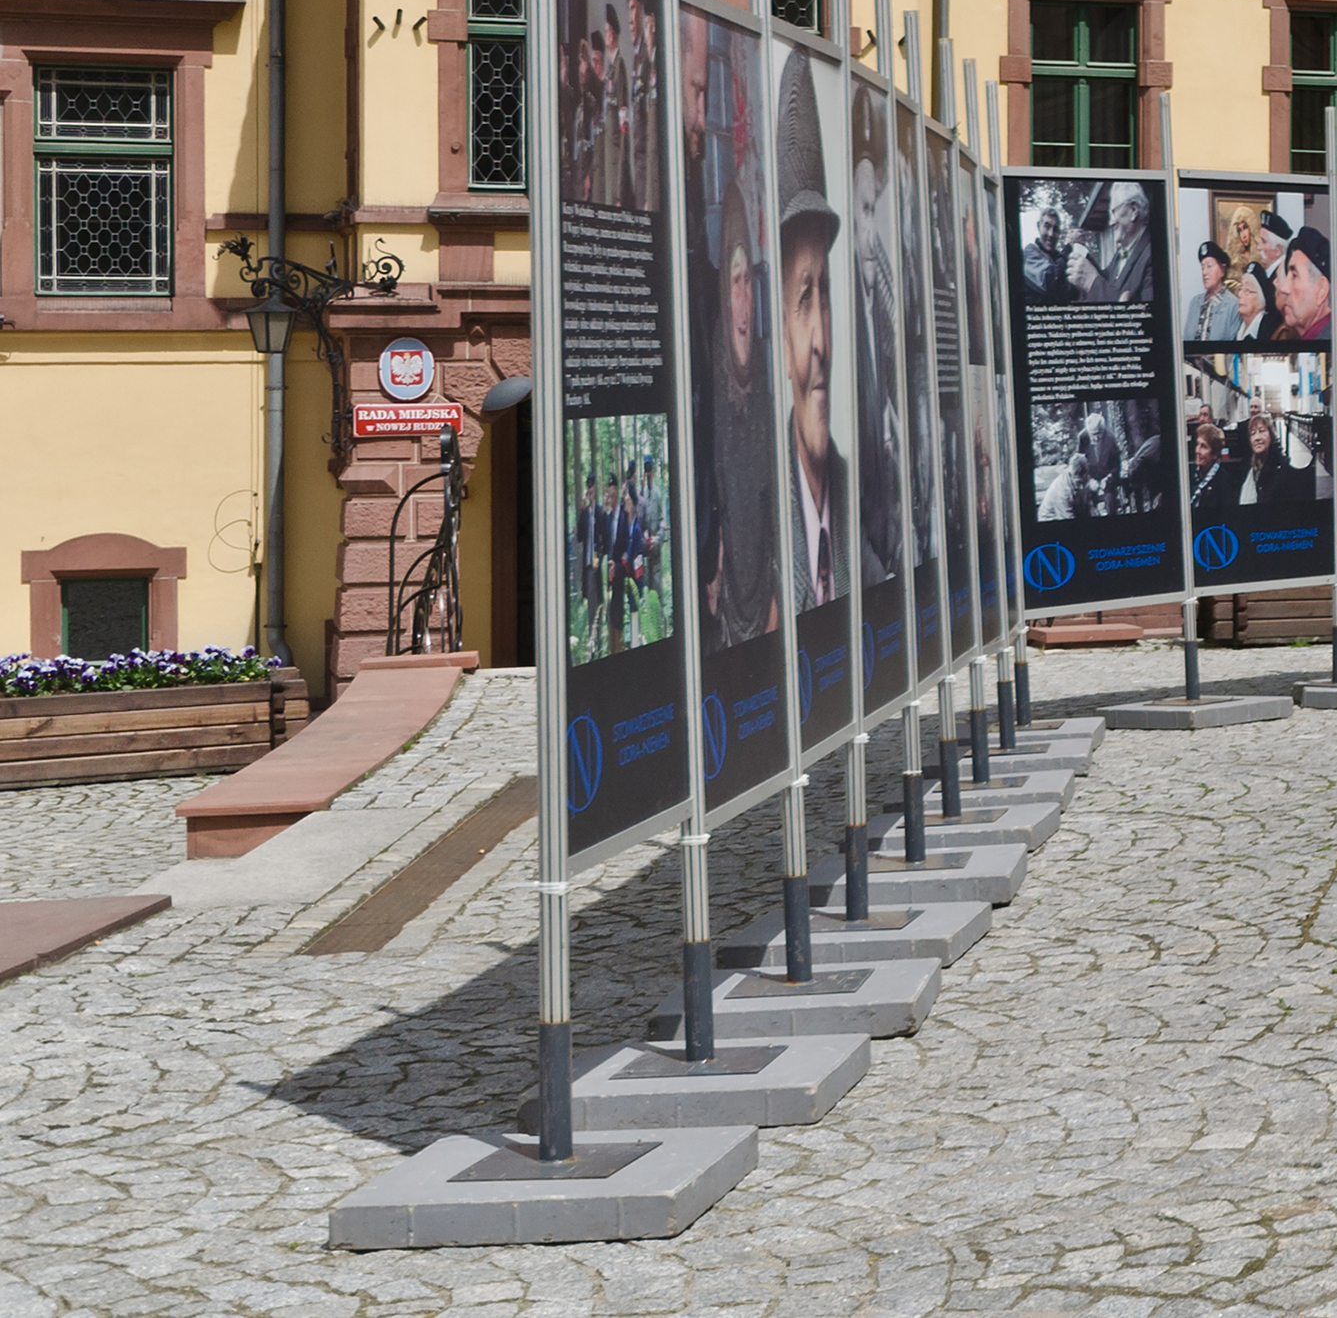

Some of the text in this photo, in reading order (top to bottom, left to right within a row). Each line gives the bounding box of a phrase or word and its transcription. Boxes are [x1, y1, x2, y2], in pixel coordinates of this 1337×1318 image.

[358, 409, 458, 420] RADA MIEJSKA
[376, 423, 412, 431] NOWEJ
[413, 422, 451, 430] RUDZ
[1250, 527, 1319, 541] STOWARZYSZENIE
[1088, 542, 1167, 559] STOWARZYSZENIE
[1256, 540, 1313, 553] ODRA-NIEMEN
[1096, 556, 1161, 571] ODRA-NIEMEN
